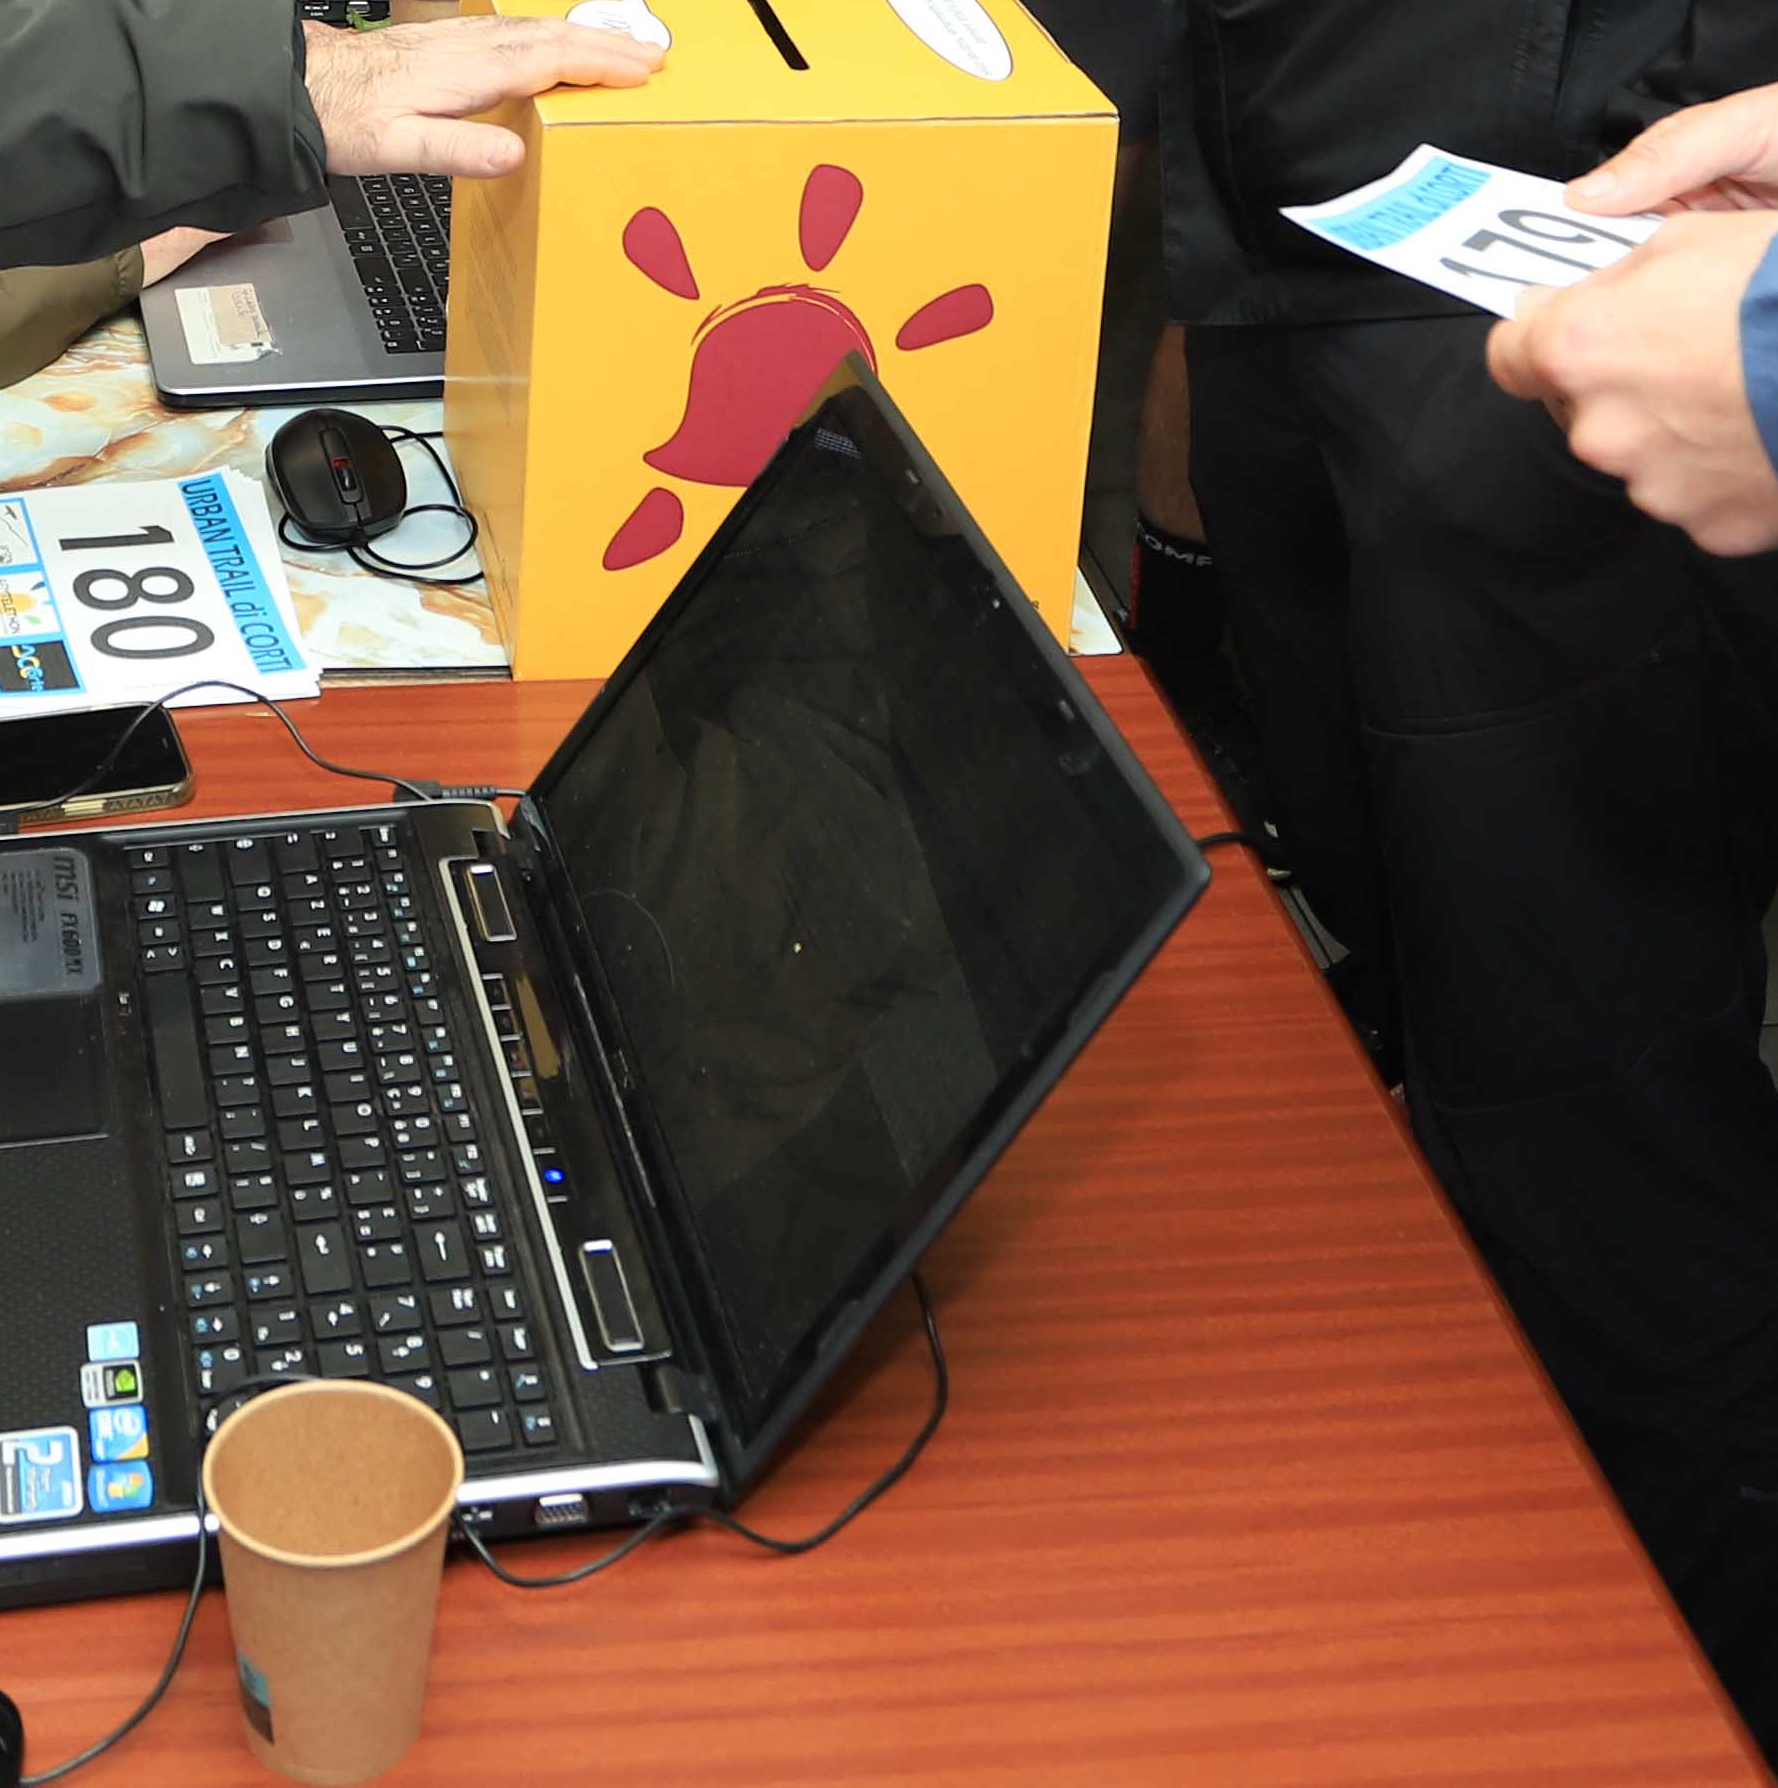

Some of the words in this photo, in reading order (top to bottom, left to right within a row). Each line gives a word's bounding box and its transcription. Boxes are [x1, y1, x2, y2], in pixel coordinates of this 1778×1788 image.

[182, 479, 233, 544] URBAN
[58, 524, 216, 660] 180
[206, 544, 257, 599] TRAIL
[230, 602, 268, 618] di
[239, 622, 294, 673] CORTI
